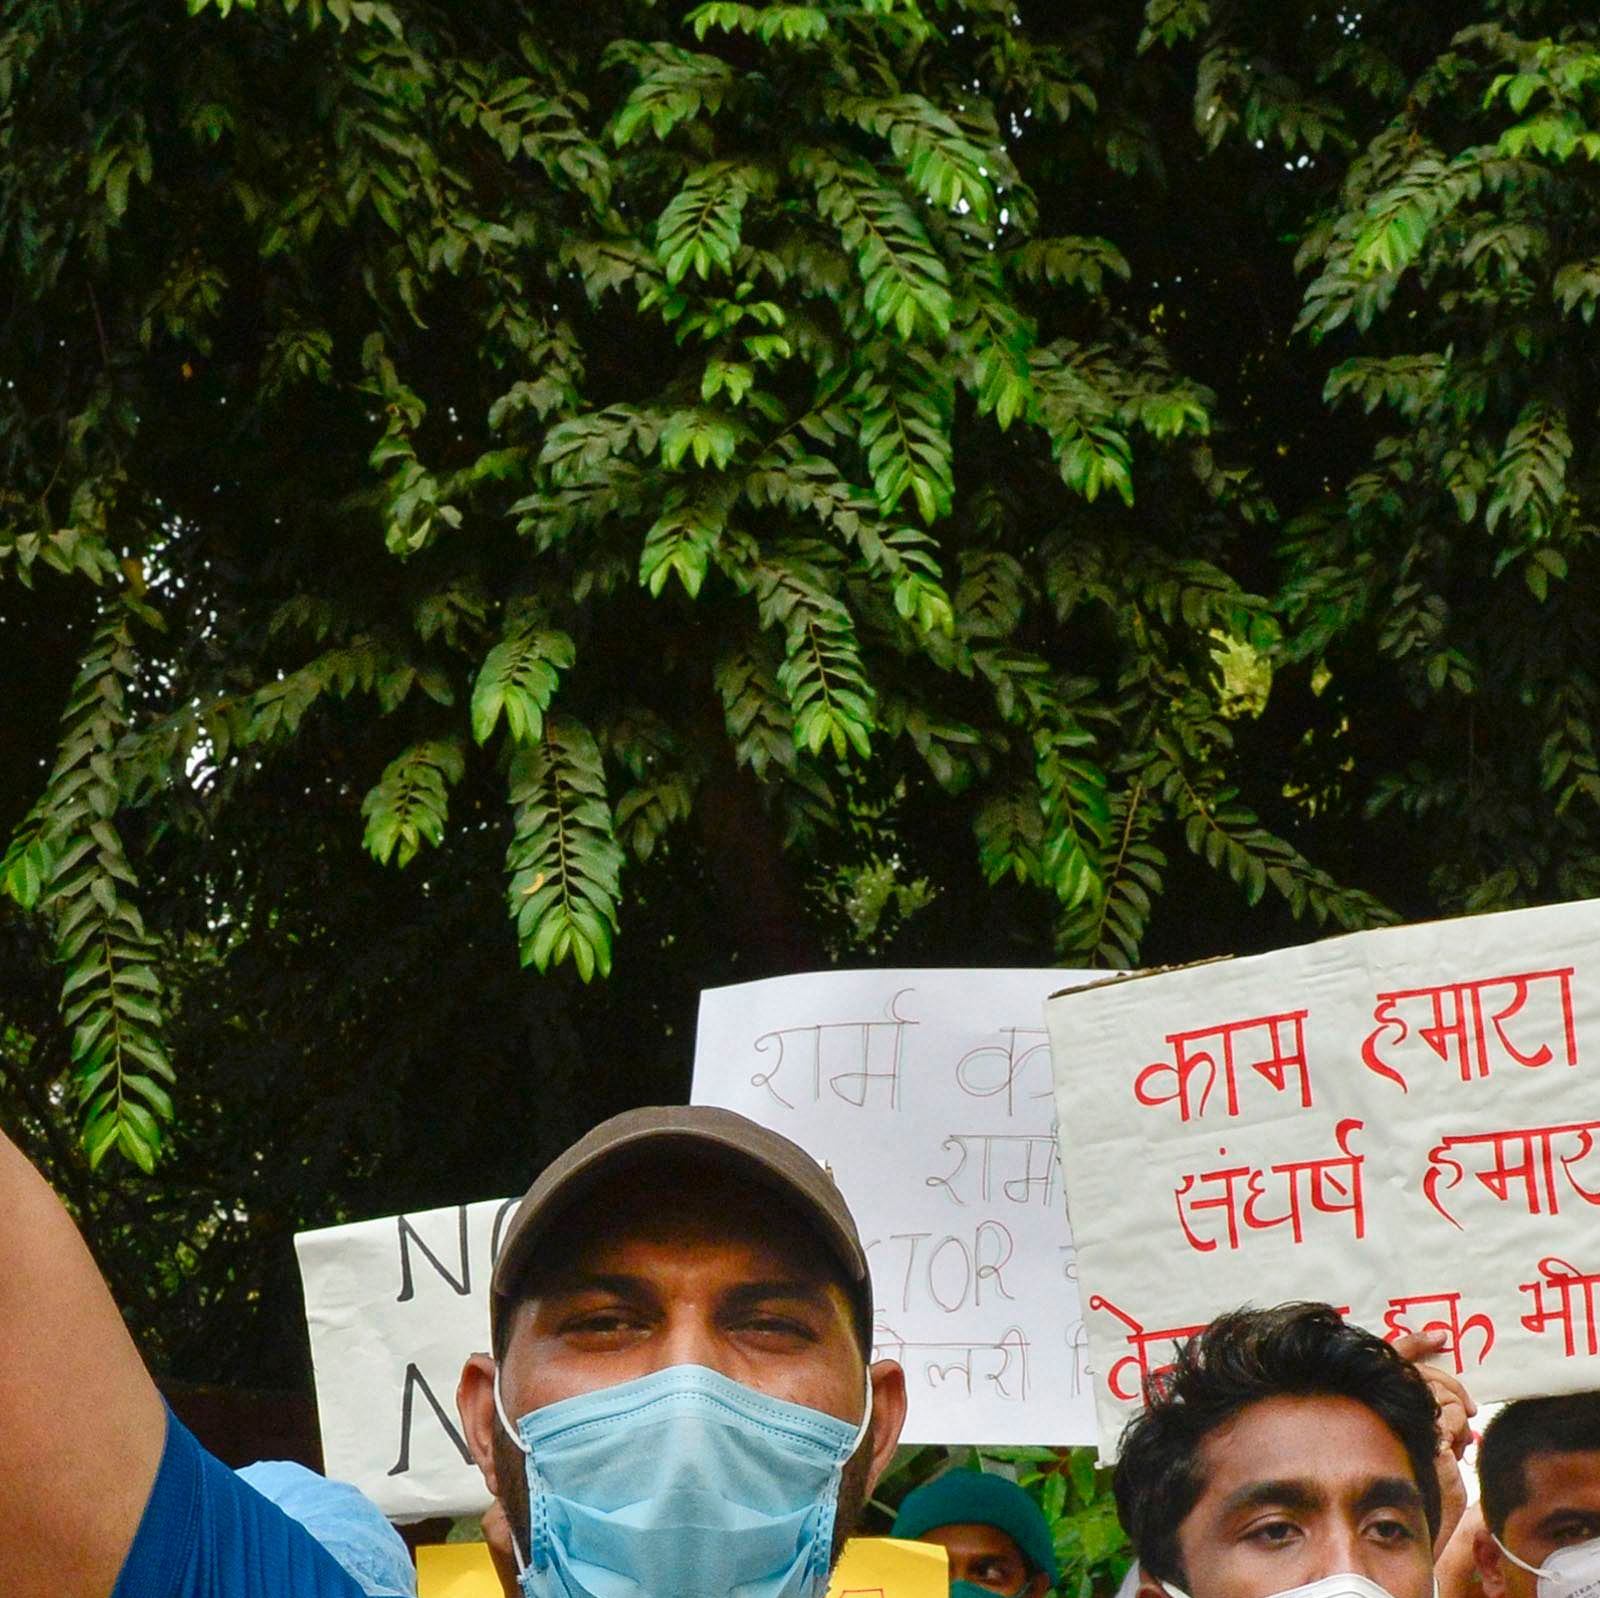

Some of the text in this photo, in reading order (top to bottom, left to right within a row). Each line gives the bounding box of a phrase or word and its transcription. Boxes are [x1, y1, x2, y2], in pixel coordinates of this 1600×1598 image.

[1133, 966, 1579, 1122] काम हमारा
[1175, 1118, 1366, 1252] संघर्ष
[866, 1219, 1016, 1313] TOR
[386, 1361, 477, 1477] N
